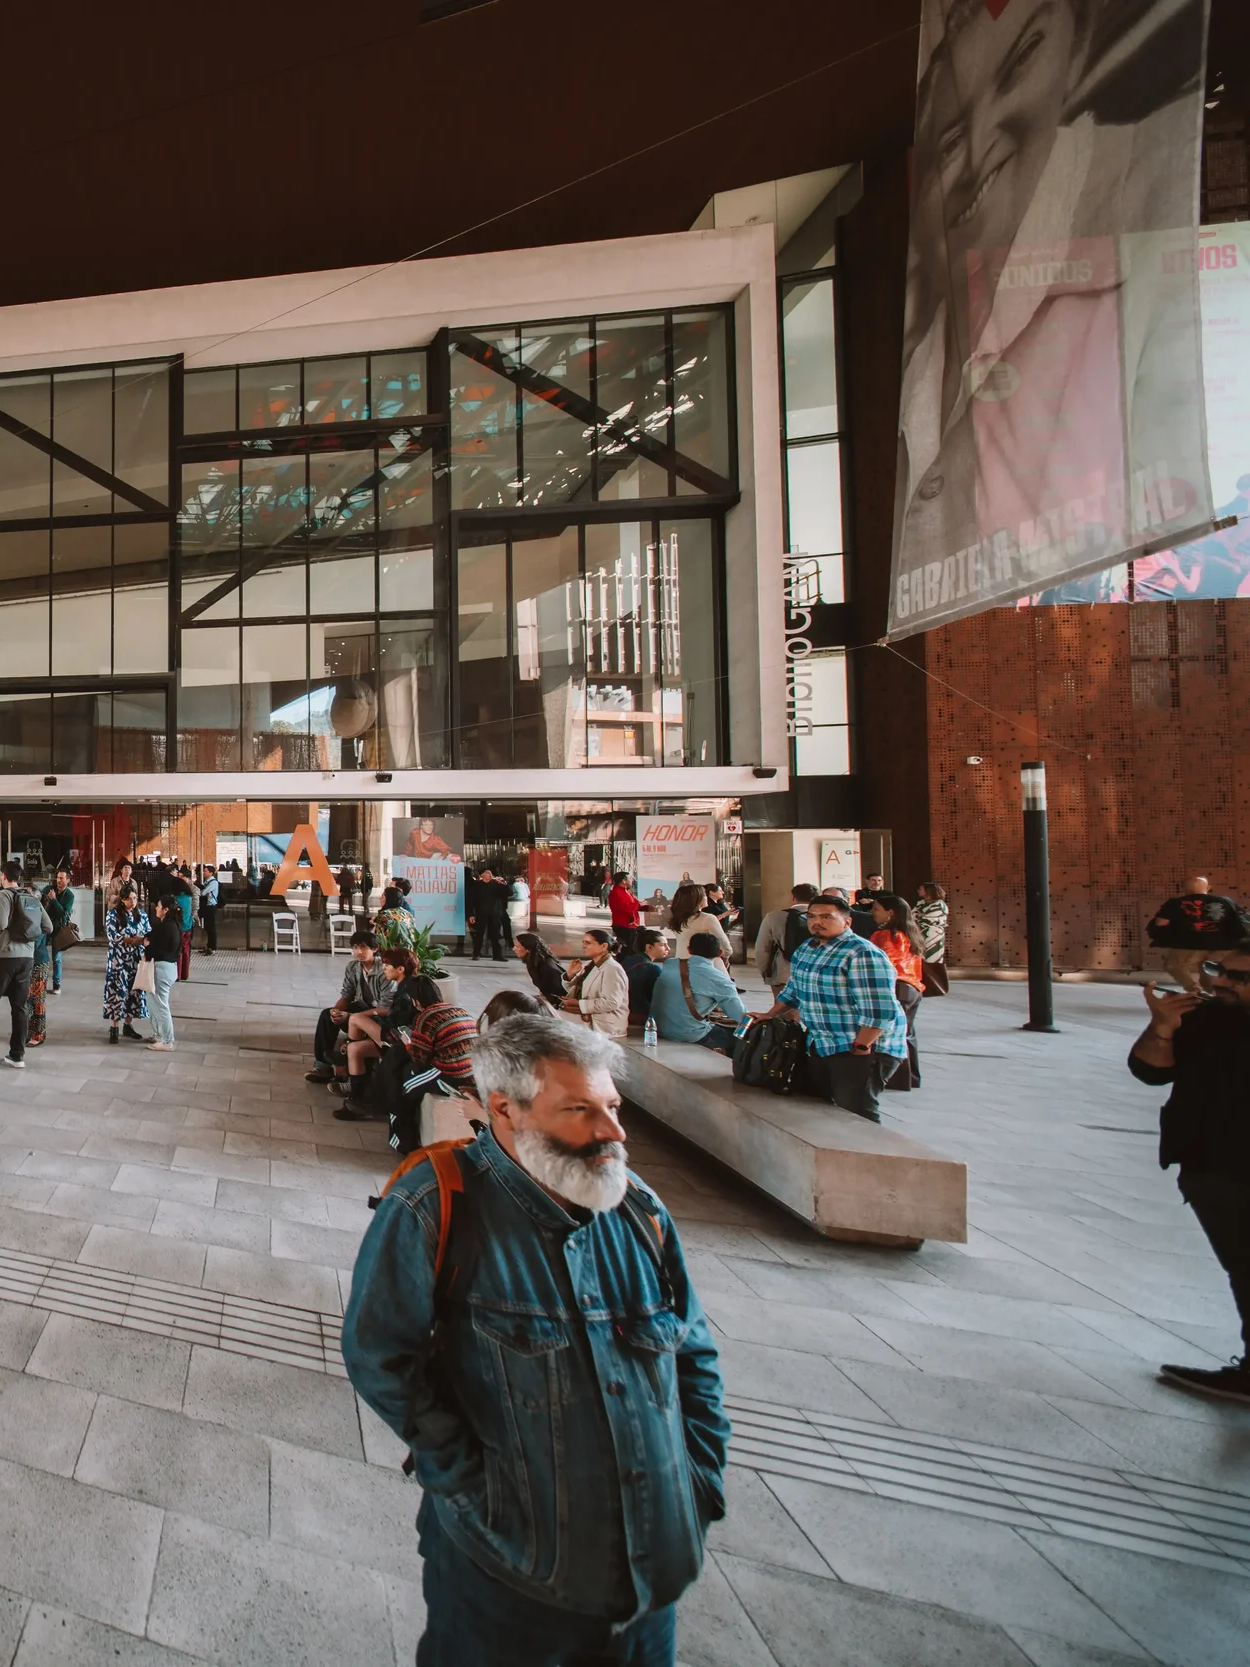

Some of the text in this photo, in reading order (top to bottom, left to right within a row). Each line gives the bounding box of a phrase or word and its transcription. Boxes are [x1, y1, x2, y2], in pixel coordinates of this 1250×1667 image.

[896, 527, 1013, 619] GABRIELA
[642, 825, 709, 841] HONOR
[825, 850, 841, 864] A
